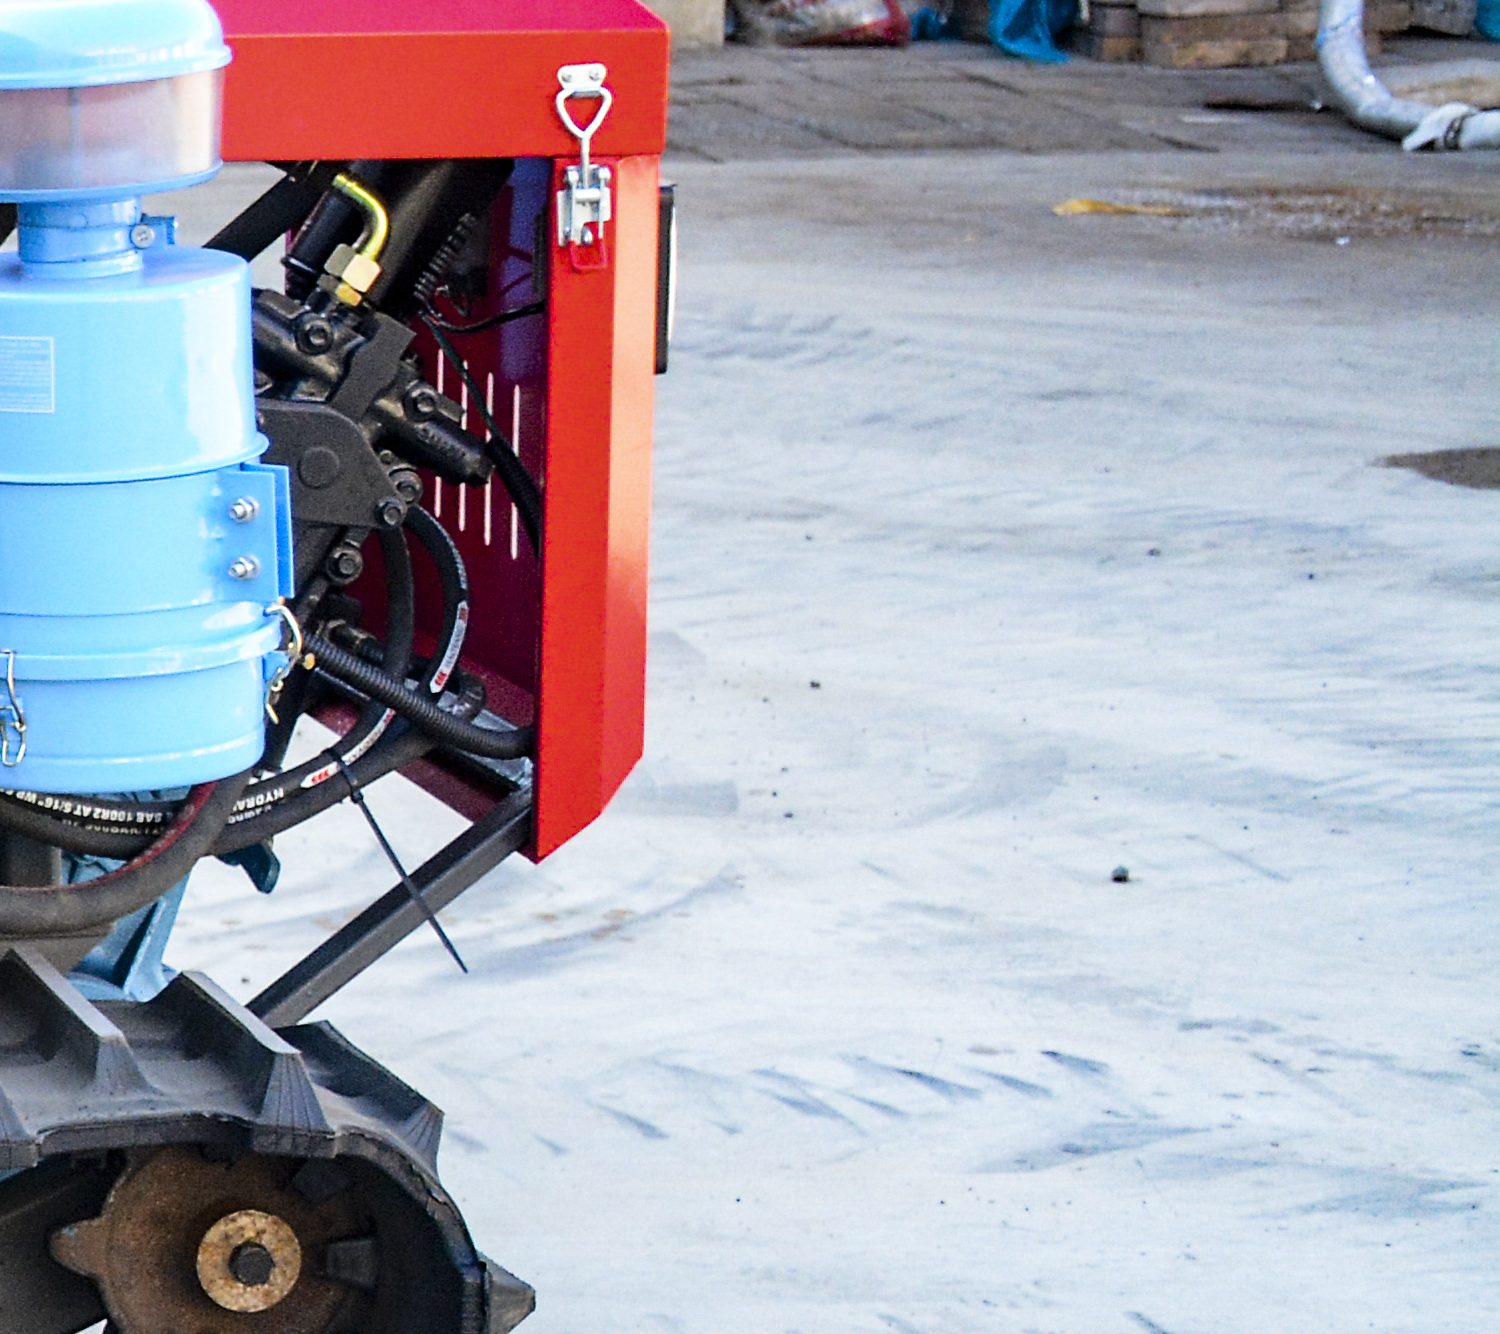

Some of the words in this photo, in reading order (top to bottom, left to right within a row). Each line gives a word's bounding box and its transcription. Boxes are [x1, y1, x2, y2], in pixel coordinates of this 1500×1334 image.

[72, 802, 93, 818] AT
[93, 806, 133, 823] 100R2
[136, 810, 163, 824] SAE
